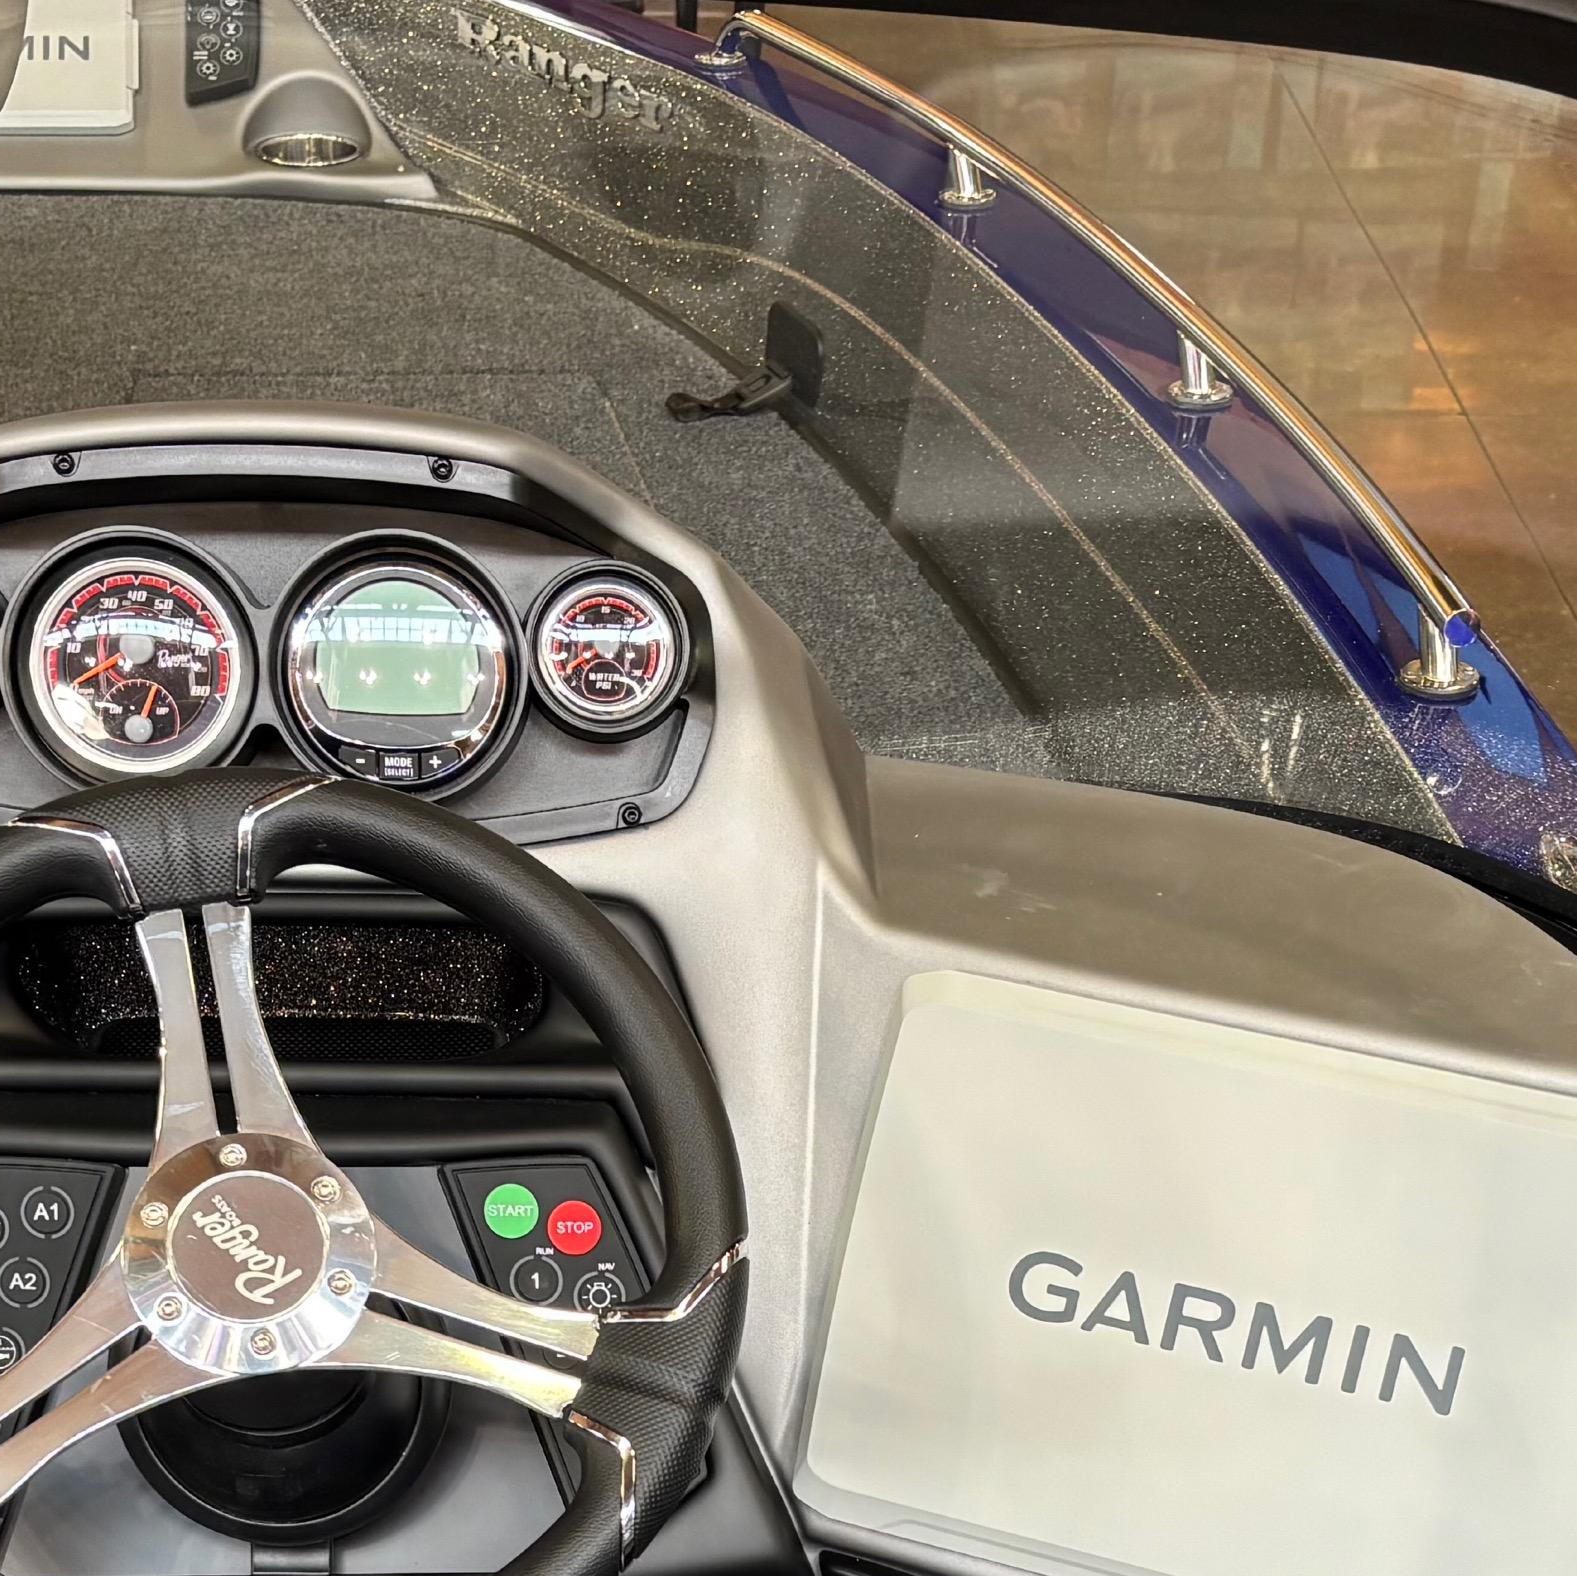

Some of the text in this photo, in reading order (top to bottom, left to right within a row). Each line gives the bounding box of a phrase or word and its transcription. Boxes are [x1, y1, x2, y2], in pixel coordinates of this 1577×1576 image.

[455, 8, 672, 132] Ranger
[127, 590, 147, 602] 40
[99, 597, 119, 609] 30
[154, 598, 174, 610] 50
[190, 685, 211, 697] 80
[384, 756, 413, 768] MODE
[33, 1202, 60, 1221] A1
[488, 1204, 534, 1217] START
[556, 1221, 595, 1235] STOP
[191, 1210, 303, 1305] Ranger
[535, 1247, 555, 1256] RUN
[597, 1262, 616, 1272] NAV
[9, 1272, 38, 1291] A2
[531, 1272, 541, 1290] 1
[1007, 1250, 1466, 1417] GARMIN
